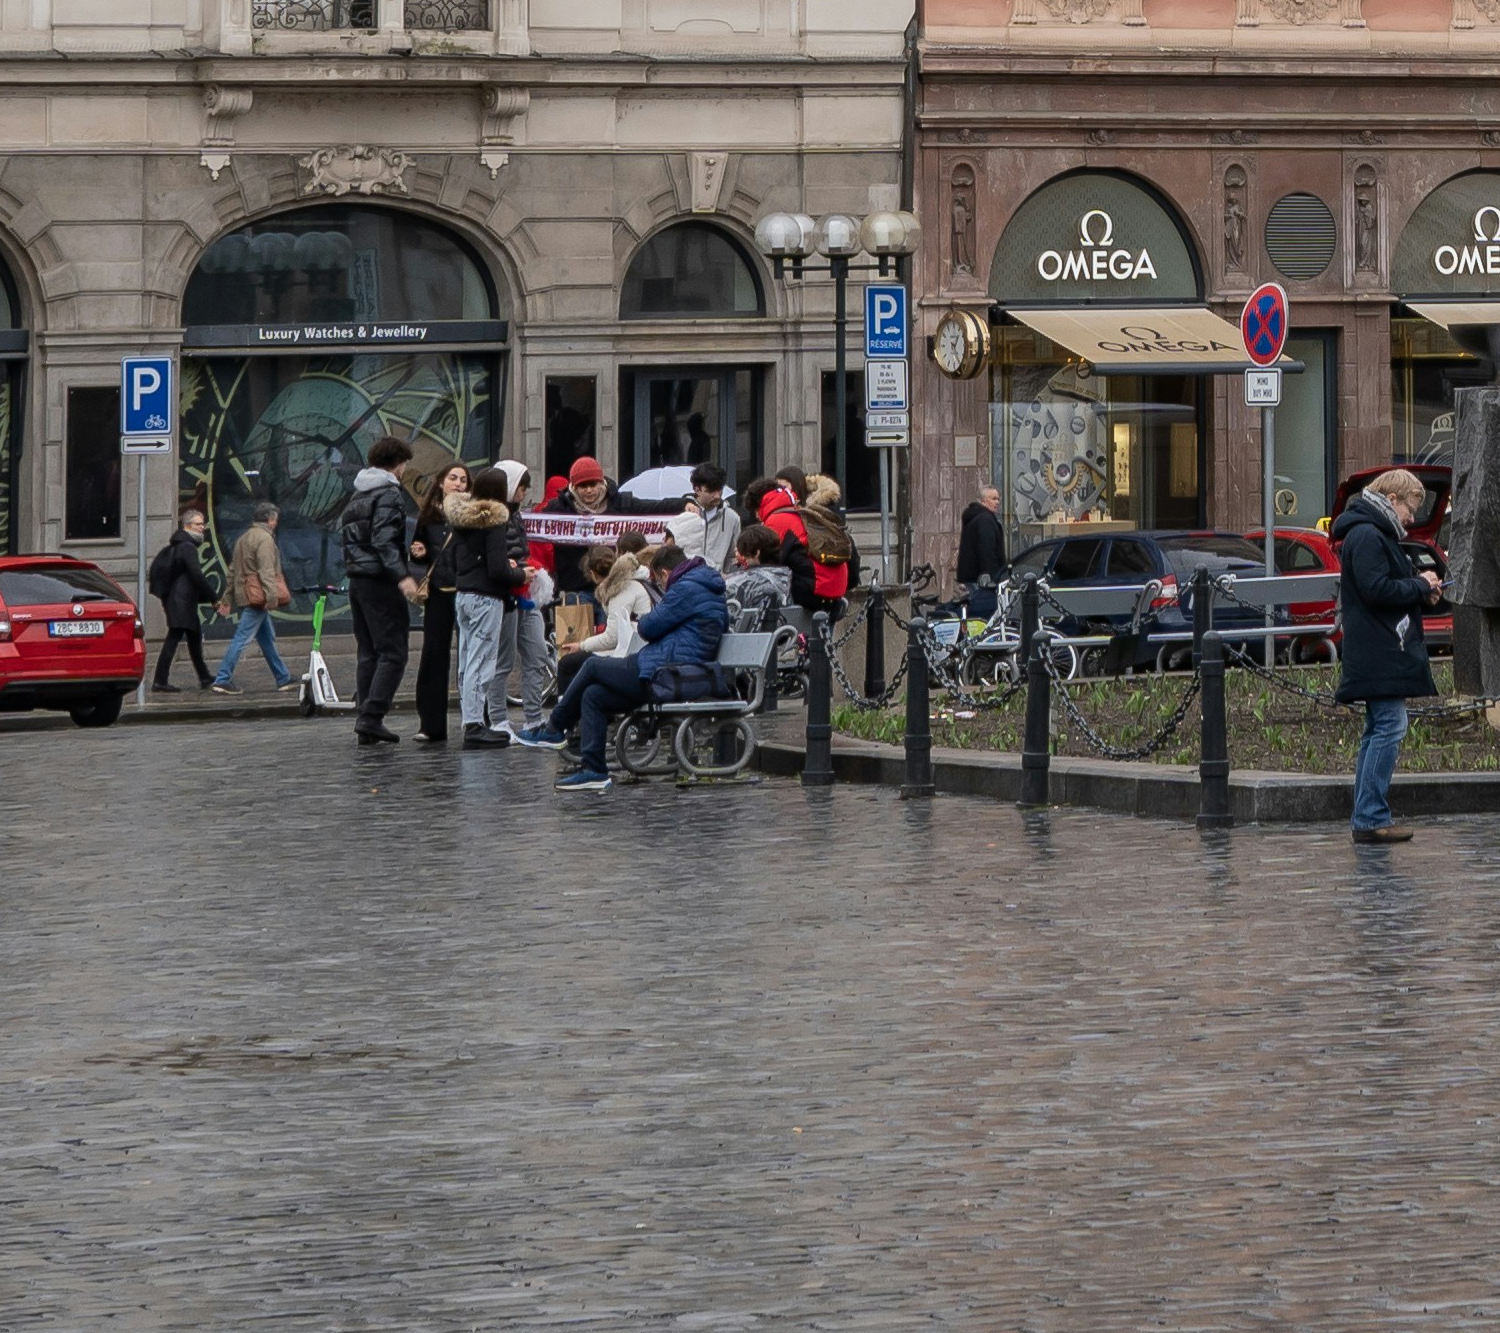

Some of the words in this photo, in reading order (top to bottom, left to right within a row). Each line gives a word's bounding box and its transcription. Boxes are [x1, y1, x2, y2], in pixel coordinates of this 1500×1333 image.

[1037, 248, 1158, 281] OMEGA
[874, 294, 898, 335] P
[258, 327, 300, 342] Luxury
[304, 326, 354, 339] Watches
[357, 326, 366, 338] &
[370, 324, 428, 339] Jewellery
[1097, 339, 1239, 353] OMEGA
[133, 367, 161, 411] P
